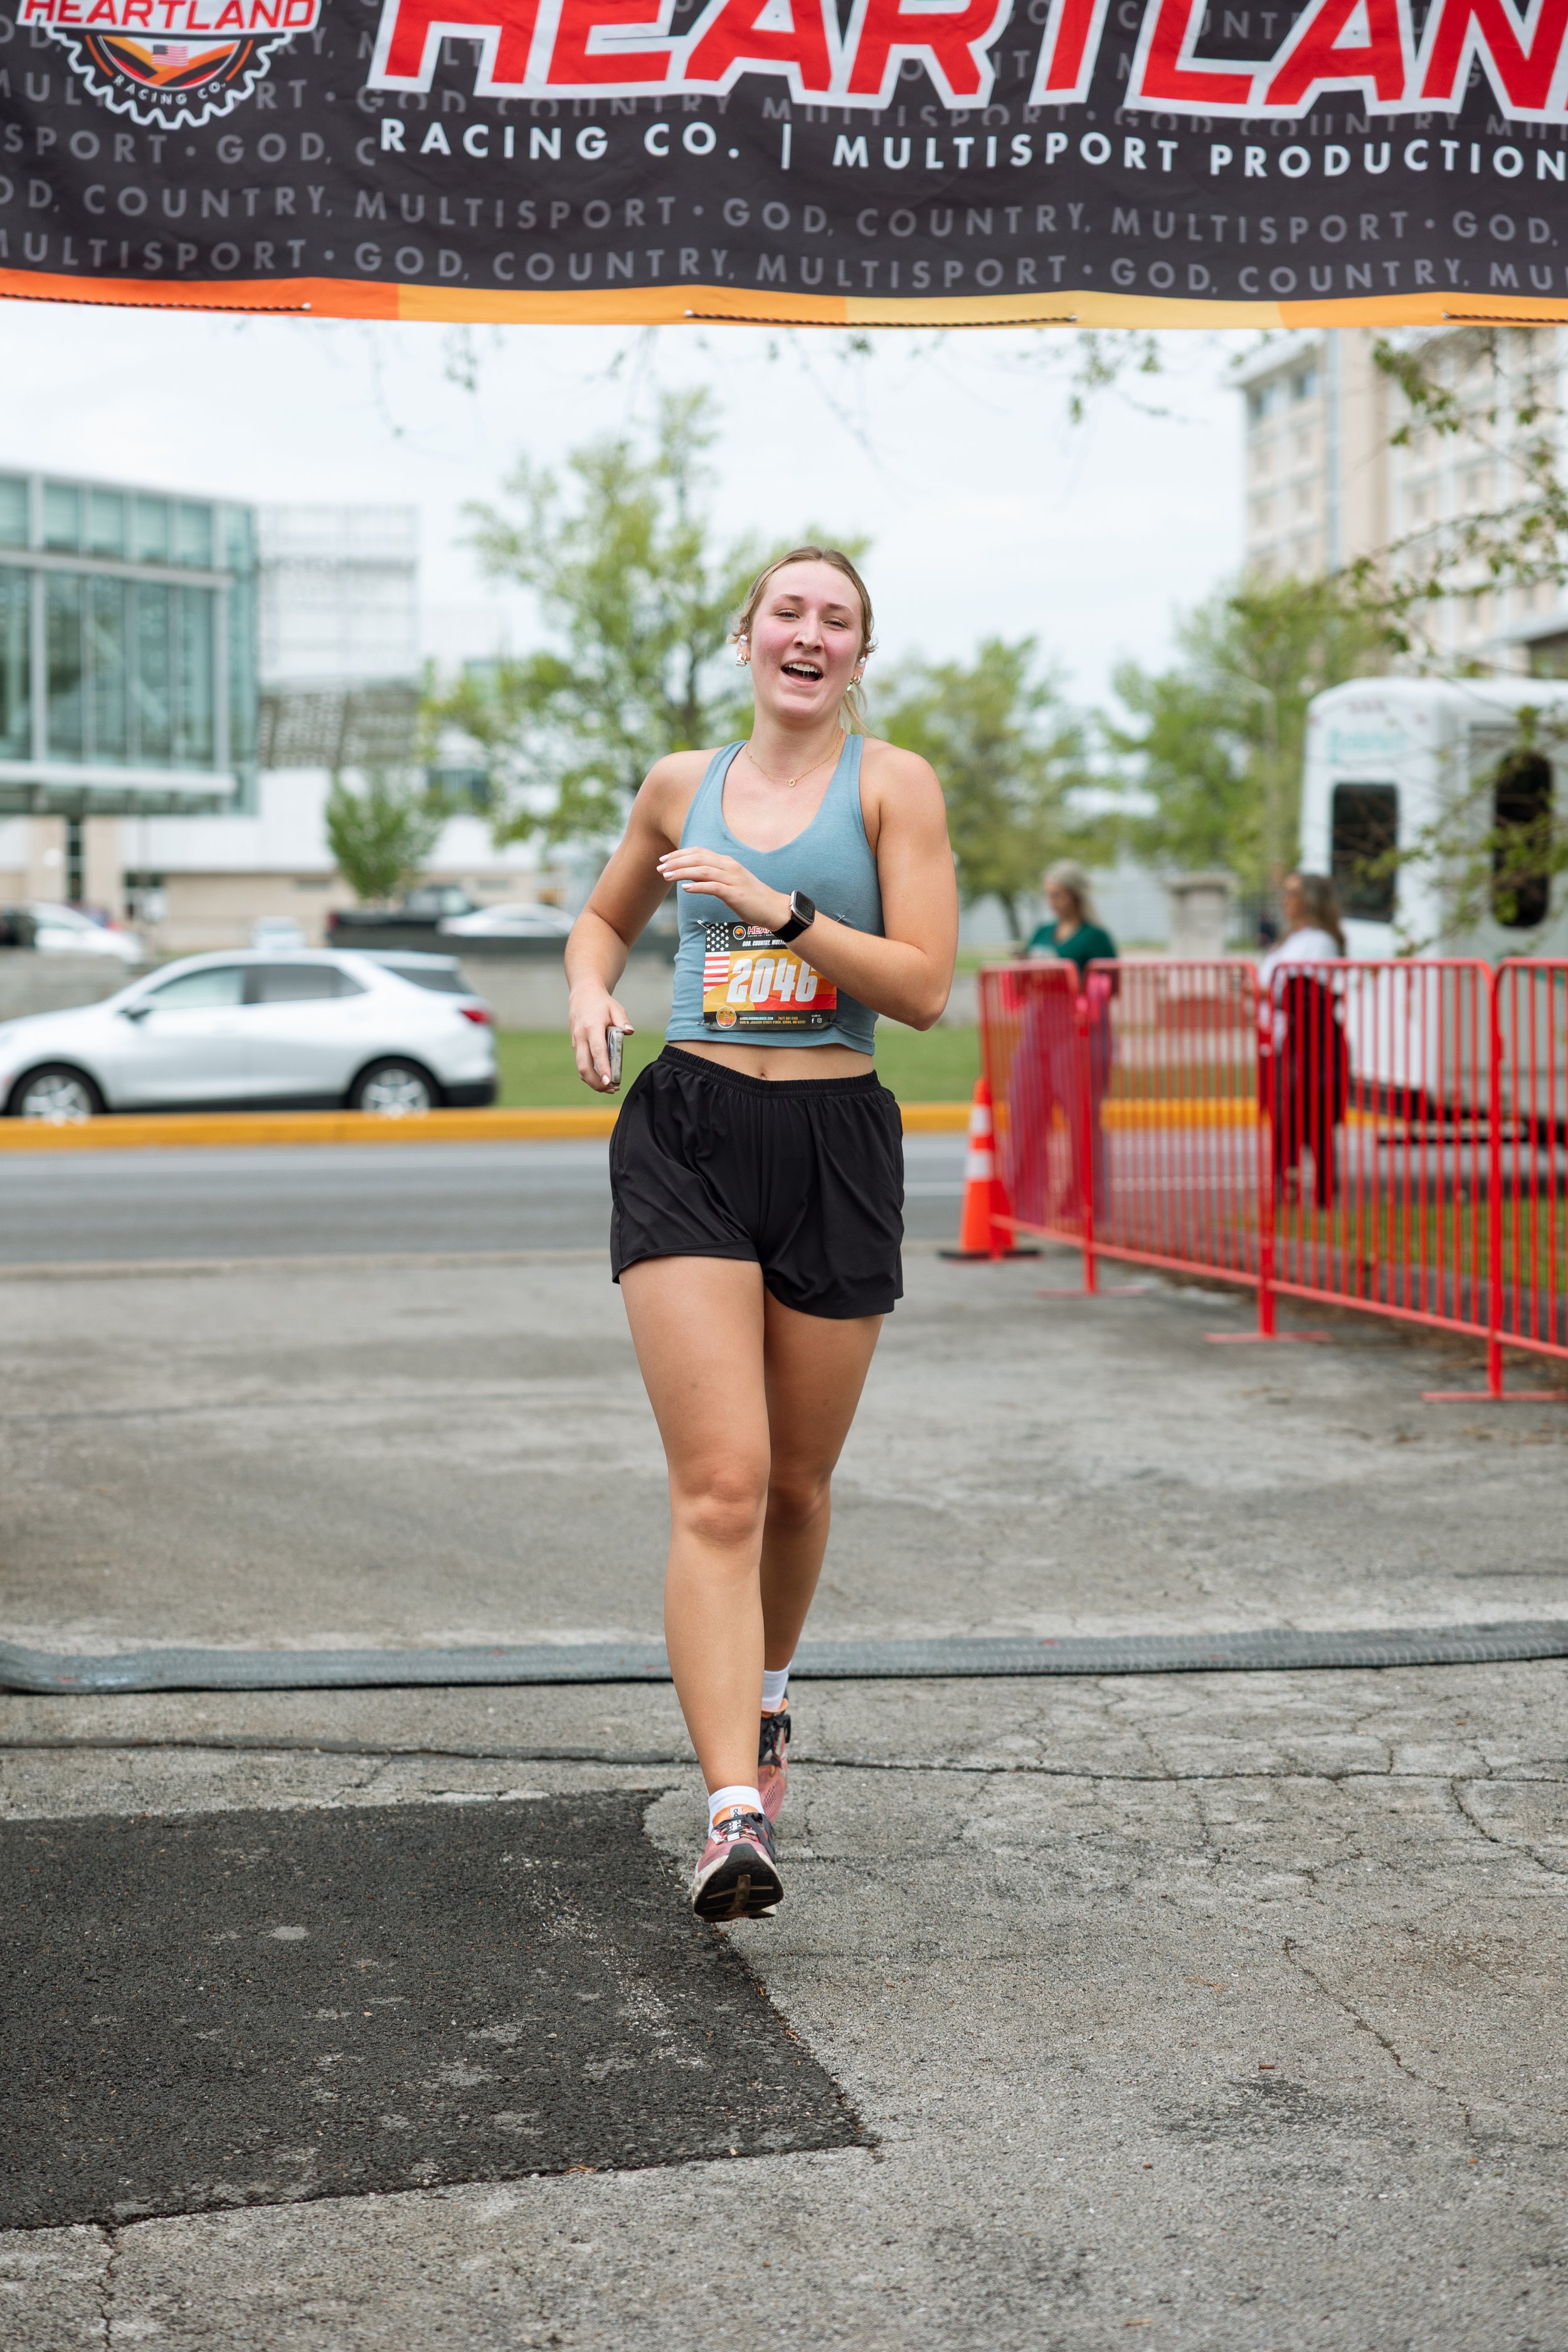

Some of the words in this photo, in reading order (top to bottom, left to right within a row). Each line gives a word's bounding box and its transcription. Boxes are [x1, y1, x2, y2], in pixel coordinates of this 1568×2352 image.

[16, 0, 322, 31] HEARTLAND
[365, 0, 1568, 124] HEARLAN
[112, 73, 188, 105] RACING
[216, 132, 332, 164] GOD,
[381, 118, 608, 161] RACING
[644, 122, 739, 159] CO.
[832, 132, 1179, 172] MULTISPORT
[1210, 138, 1567, 181] PRODUCTION
[83, 185, 334, 218] COUNTRY,
[354, 189, 675, 229] MULTISPORT
[722, 196, 835, 236] GOD,
[856, 202, 1091, 237] COUNTRY,
[1111, 205, 1409, 245] MULTISPORT
[1452, 210, 1559, 247] GOD,
[354, 241, 470, 281] GOD,
[492, 248, 735, 282] COUNTRY,
[756, 253, 1066, 289] MULTISPORT
[1110, 257, 1219, 294] GOD,
[1237, 258, 1470, 294] COUNTRY,
[726, 958, 818, 1004] 2046
